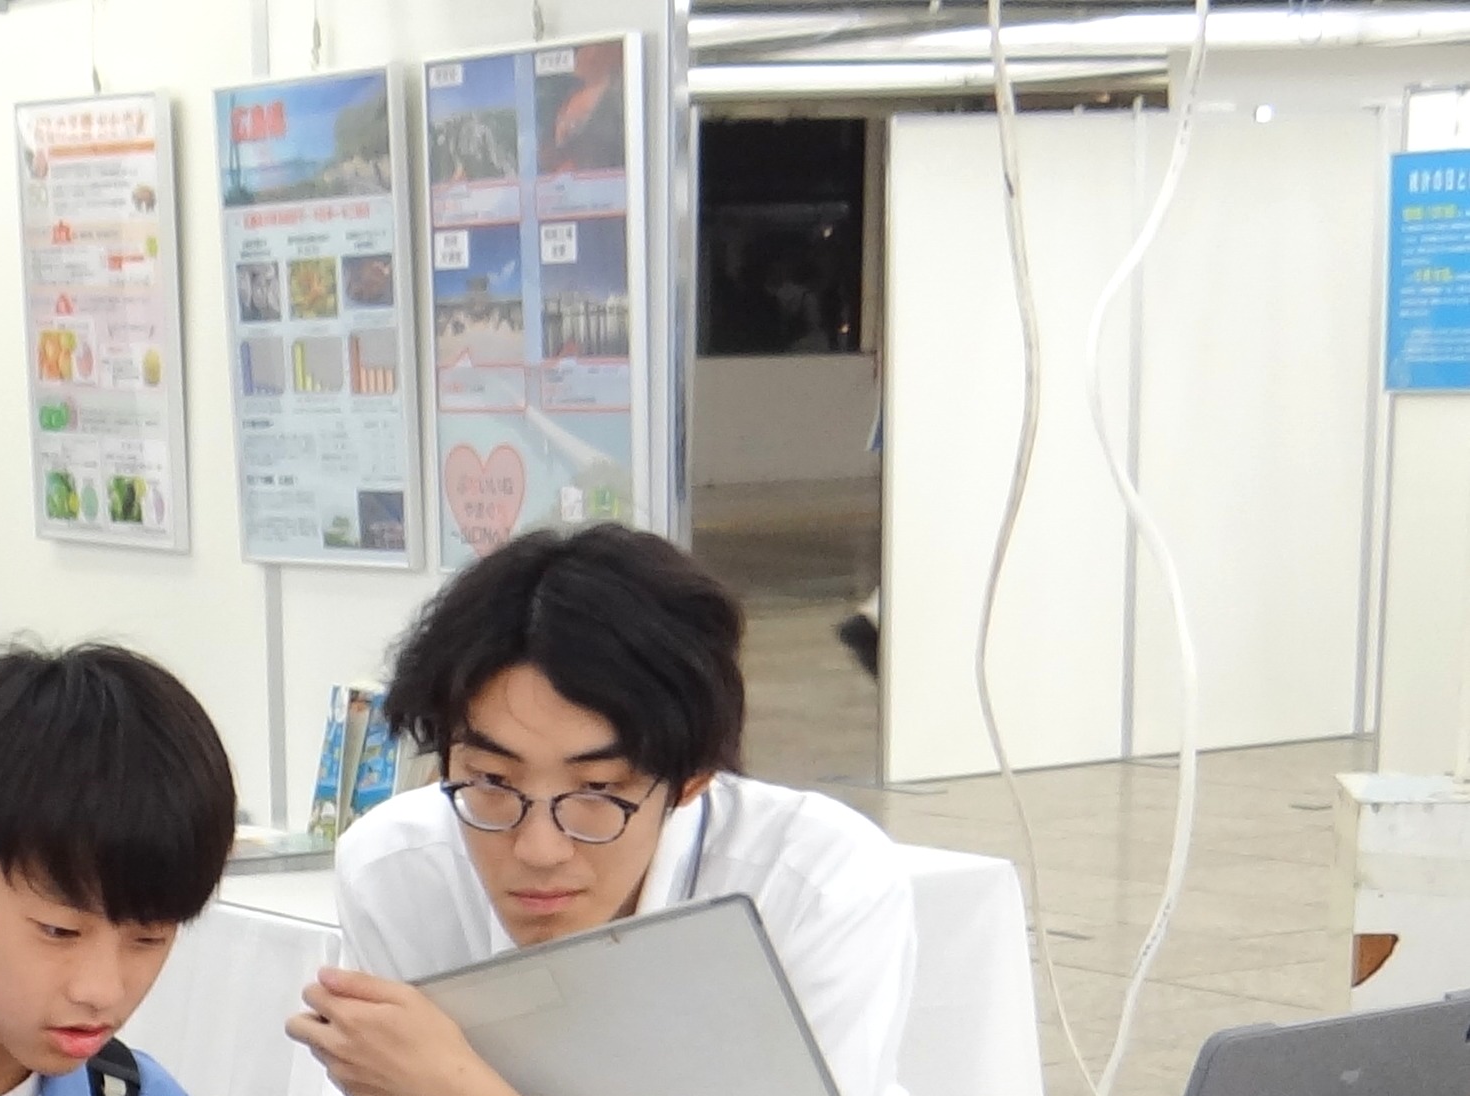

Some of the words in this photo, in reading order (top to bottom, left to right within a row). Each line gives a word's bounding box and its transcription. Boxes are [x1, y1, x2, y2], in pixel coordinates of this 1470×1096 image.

[1408, 167, 1470, 193] 統計の日と
